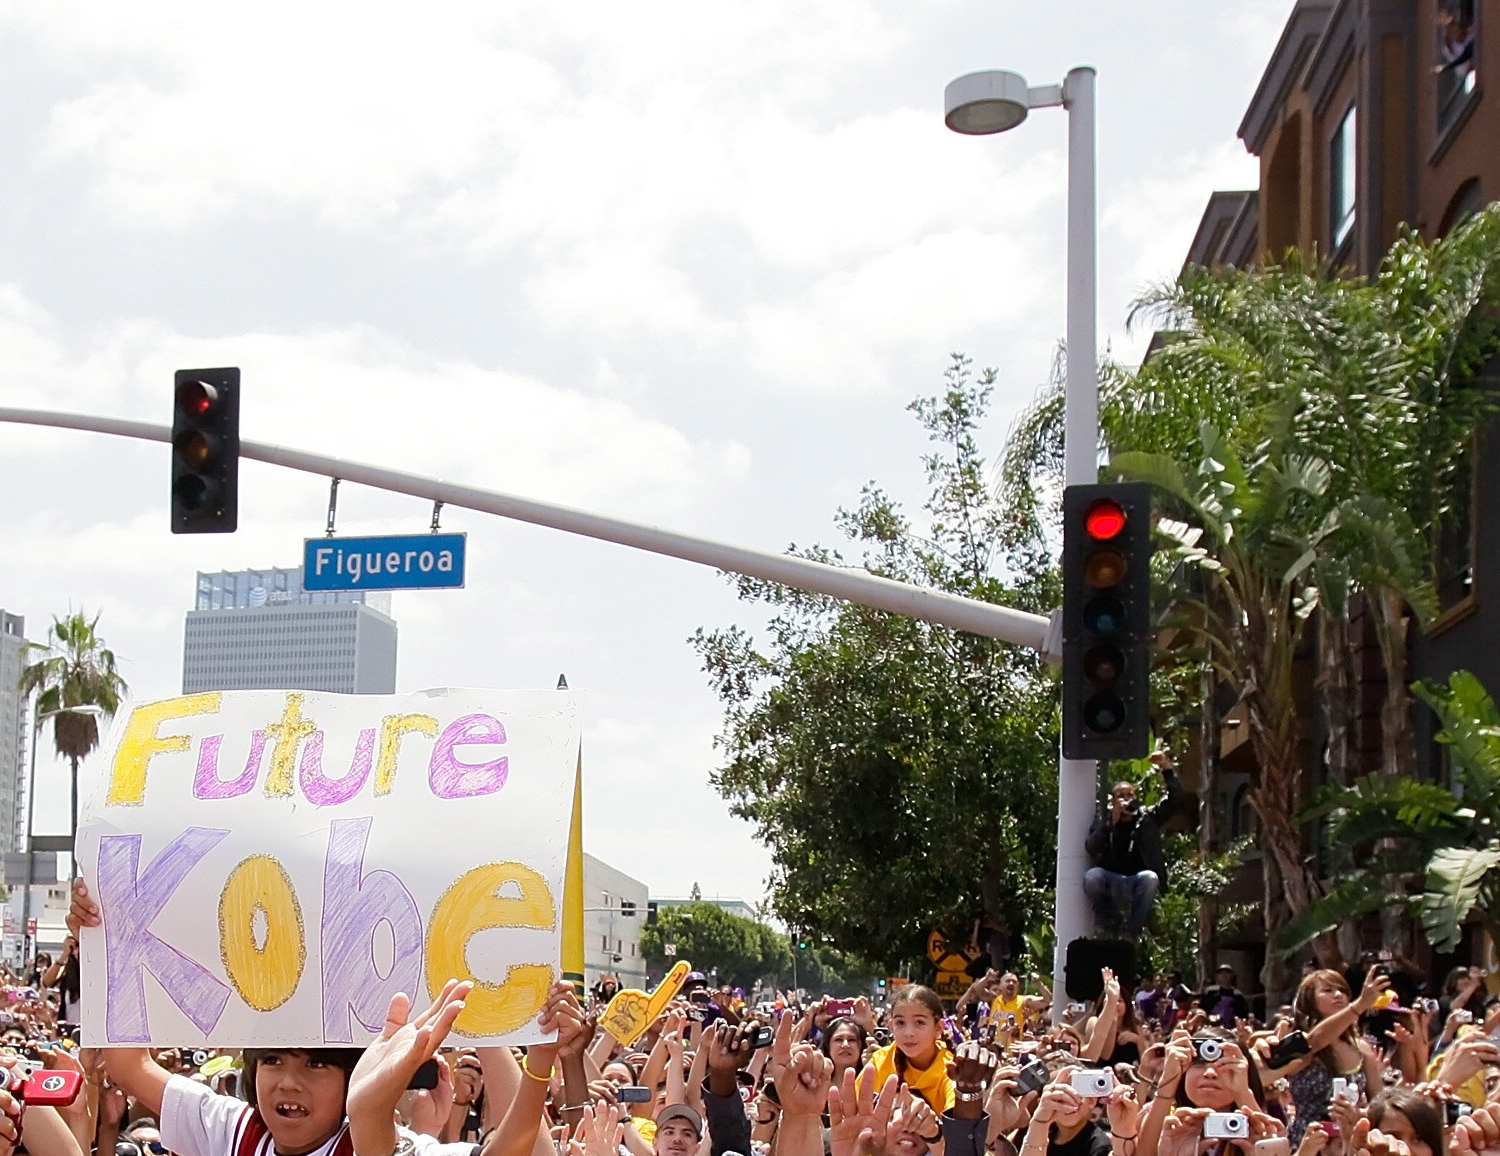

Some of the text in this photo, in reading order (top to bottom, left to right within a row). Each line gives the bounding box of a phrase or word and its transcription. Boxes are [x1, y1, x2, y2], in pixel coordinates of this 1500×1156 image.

[315, 548, 453, 583] Figueroa
[106, 690, 509, 806] Future
[98, 817, 556, 1043] Kobe
